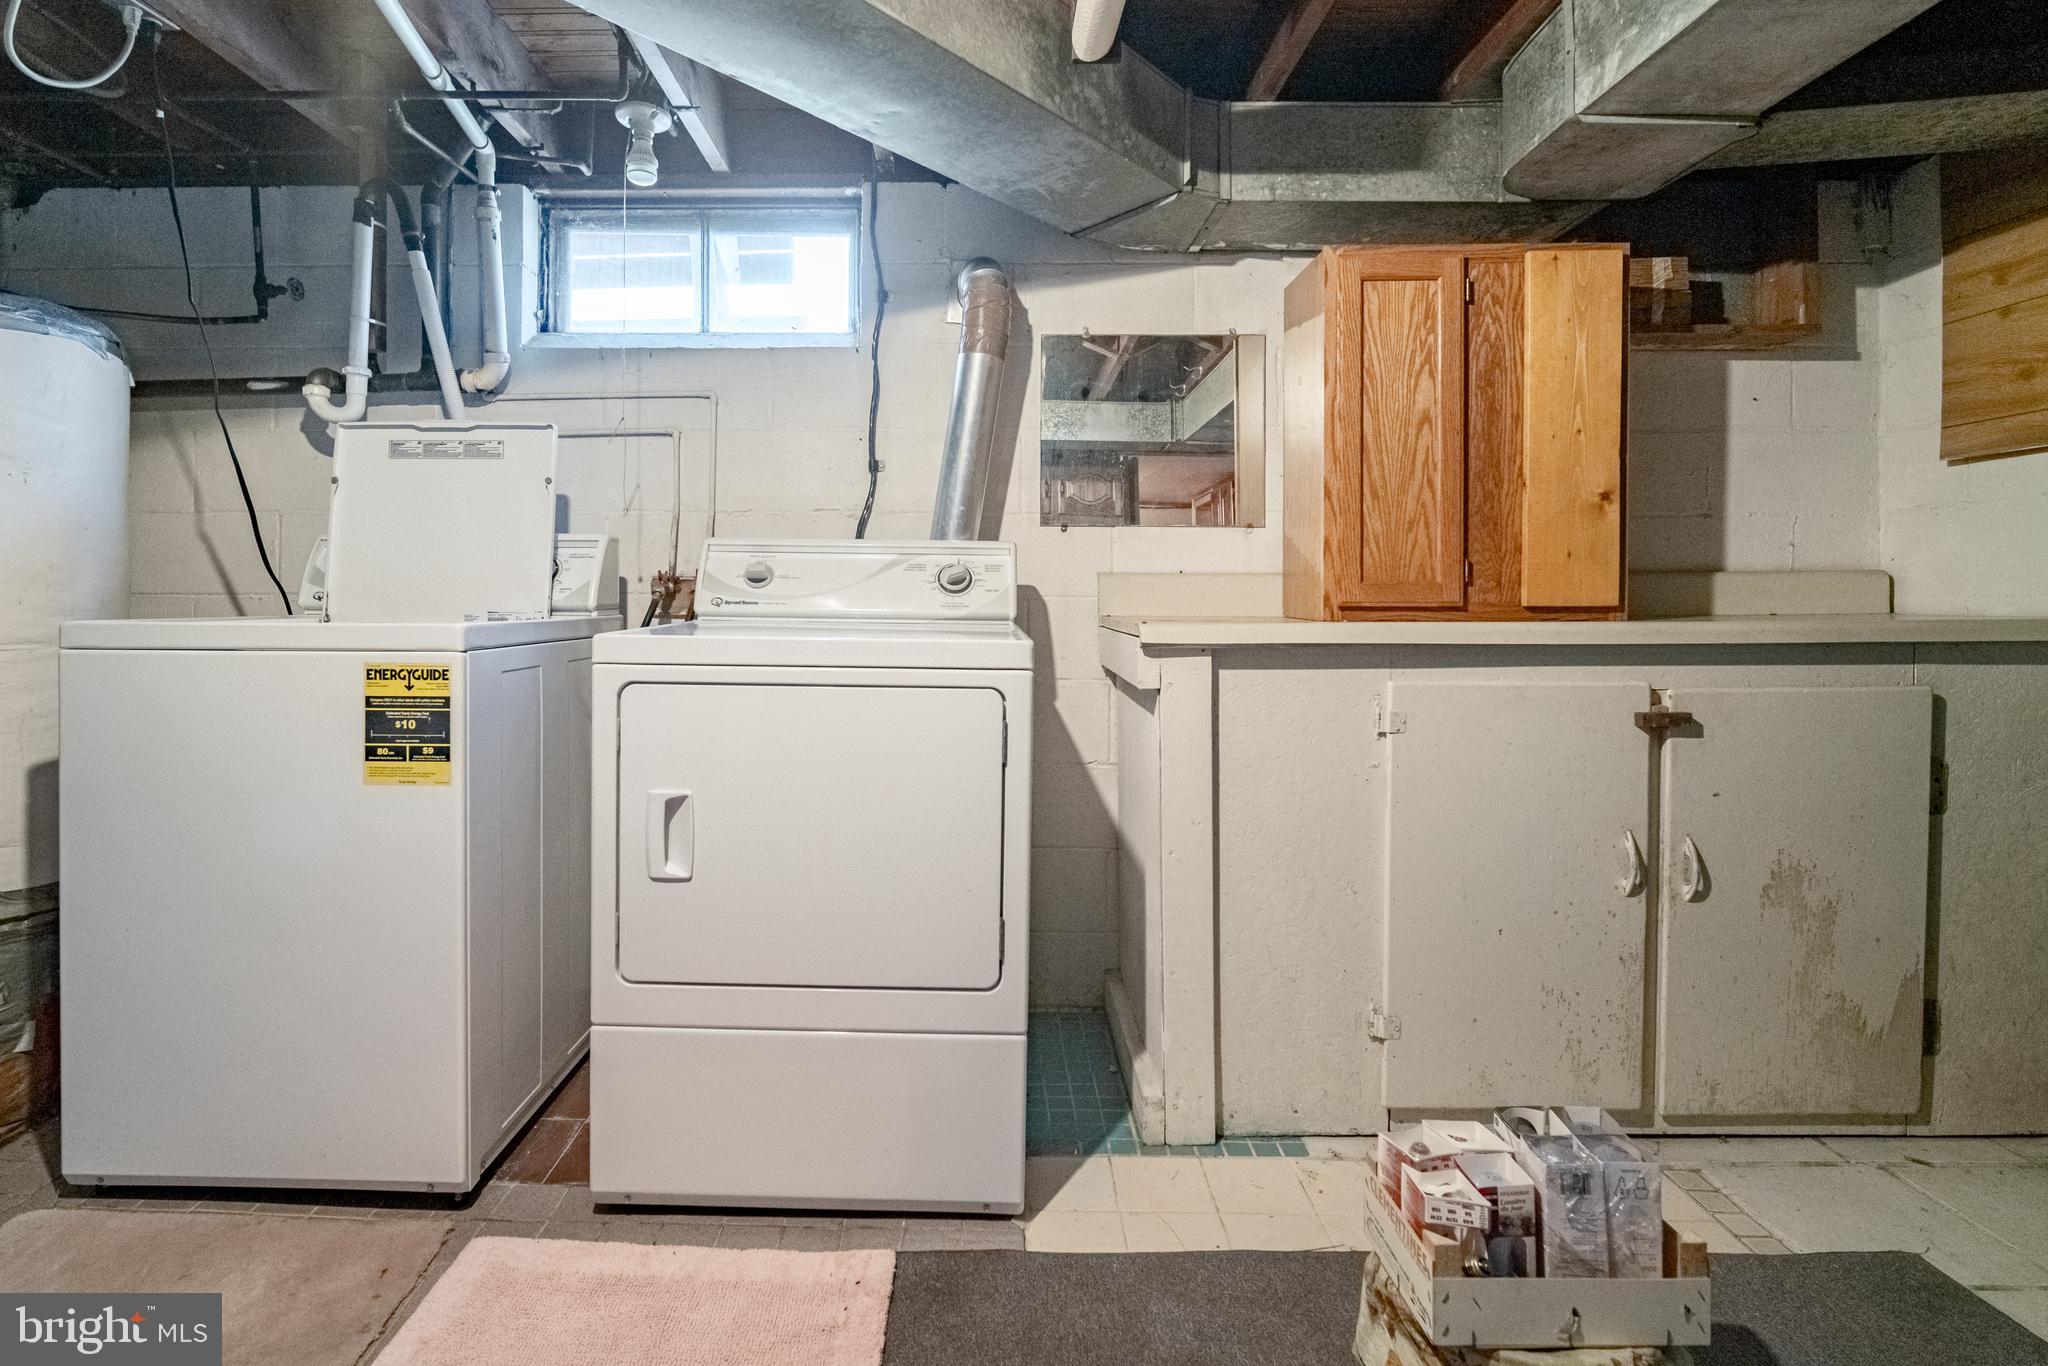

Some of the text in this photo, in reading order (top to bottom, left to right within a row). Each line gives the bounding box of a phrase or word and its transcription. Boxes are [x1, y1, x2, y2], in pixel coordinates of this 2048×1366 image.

[366, 669, 450, 681] ENERGYGUIDE
[395, 719, 416, 729] $10
[422, 747, 434, 755] $9
